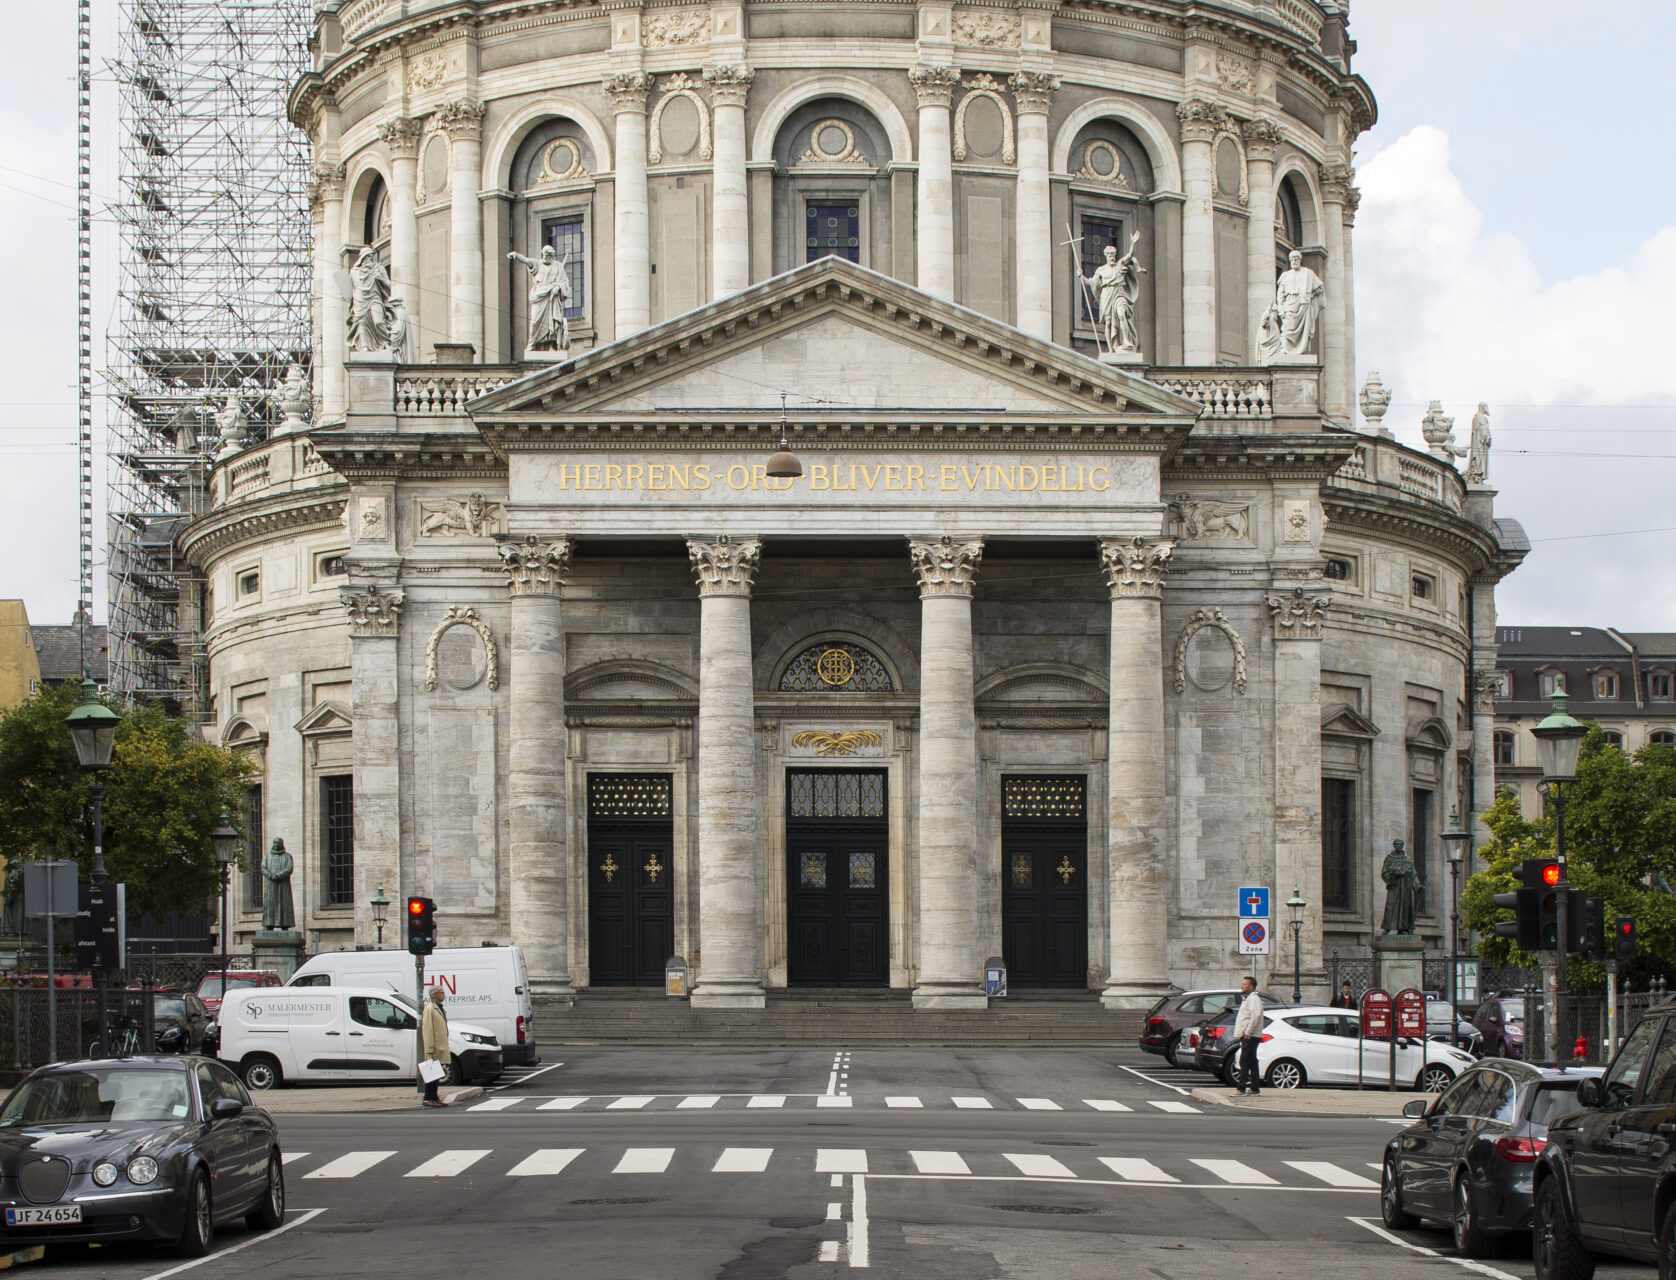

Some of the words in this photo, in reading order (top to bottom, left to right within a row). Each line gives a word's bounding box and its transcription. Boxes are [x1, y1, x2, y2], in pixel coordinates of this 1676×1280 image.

[559, 464, 712, 491] HERRENS
[727, 464, 795, 491] ORD
[809, 464, 927, 491] BLIVER
[939, 464, 1111, 492] EVINDELIG
[478, 994, 492, 1002] APS
[267, 1003, 332, 1012] MALERMESTER
[17, 1210, 32, 1222] JF
[36, 1209, 52, 1222] 24
[55, 1208, 79, 1221] 654
